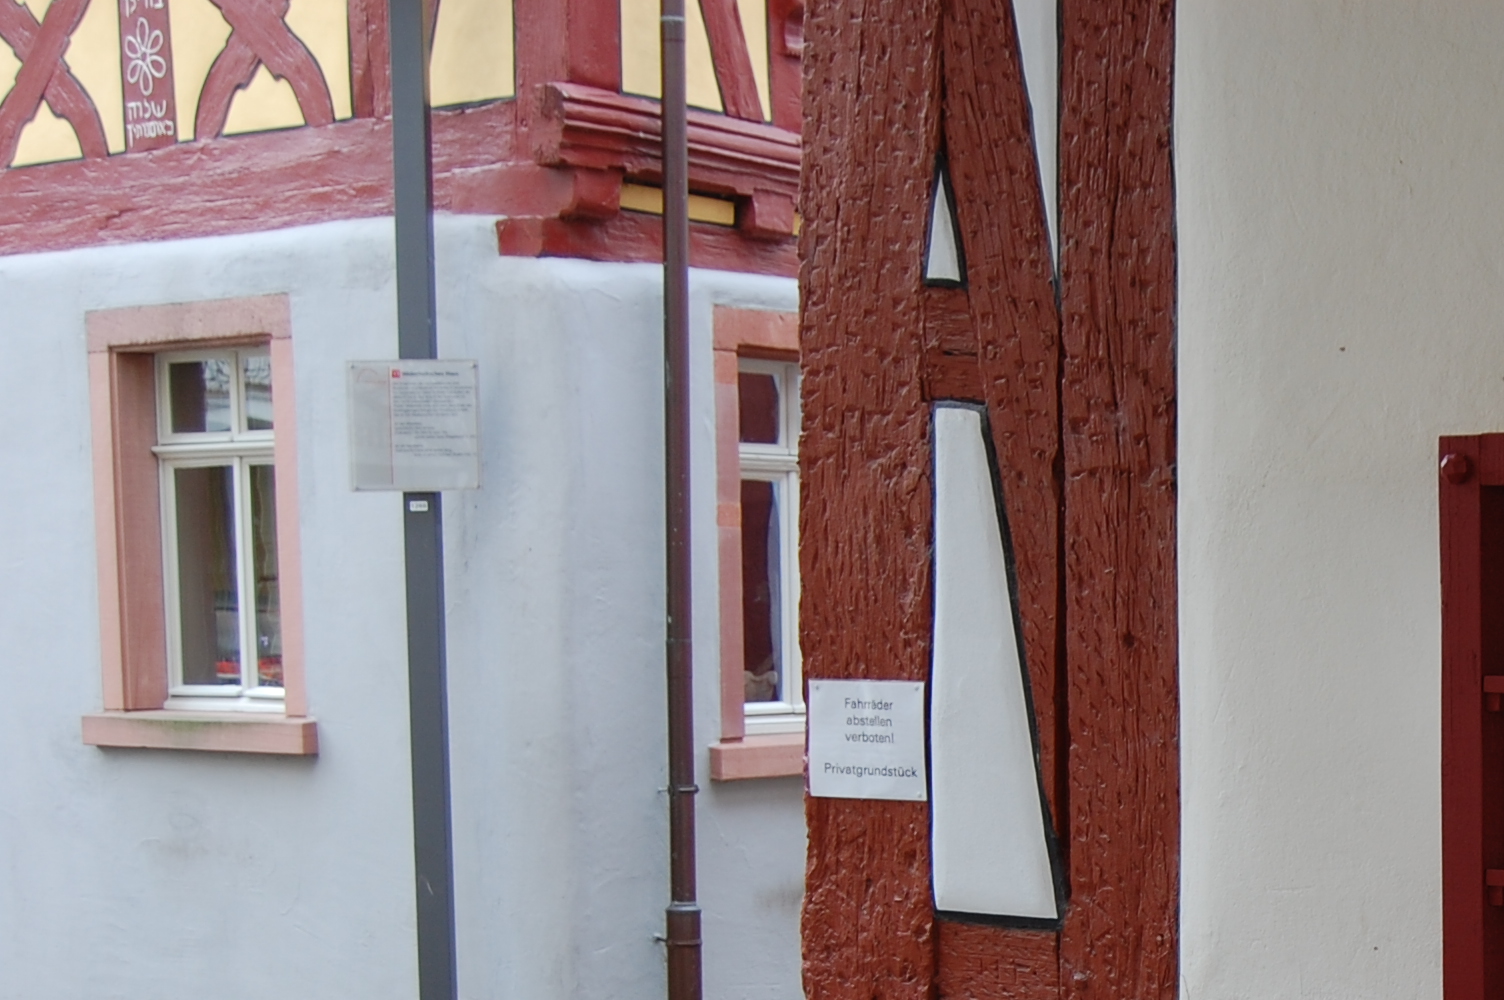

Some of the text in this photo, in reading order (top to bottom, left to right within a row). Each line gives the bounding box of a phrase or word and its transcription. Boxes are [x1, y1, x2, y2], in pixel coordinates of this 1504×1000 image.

[844, 697, 894, 711] Fahrräder
[846, 715, 893, 728] abstellen
[844, 732, 895, 744] verboten!
[824, 762, 918, 778] Privatgrundstück
